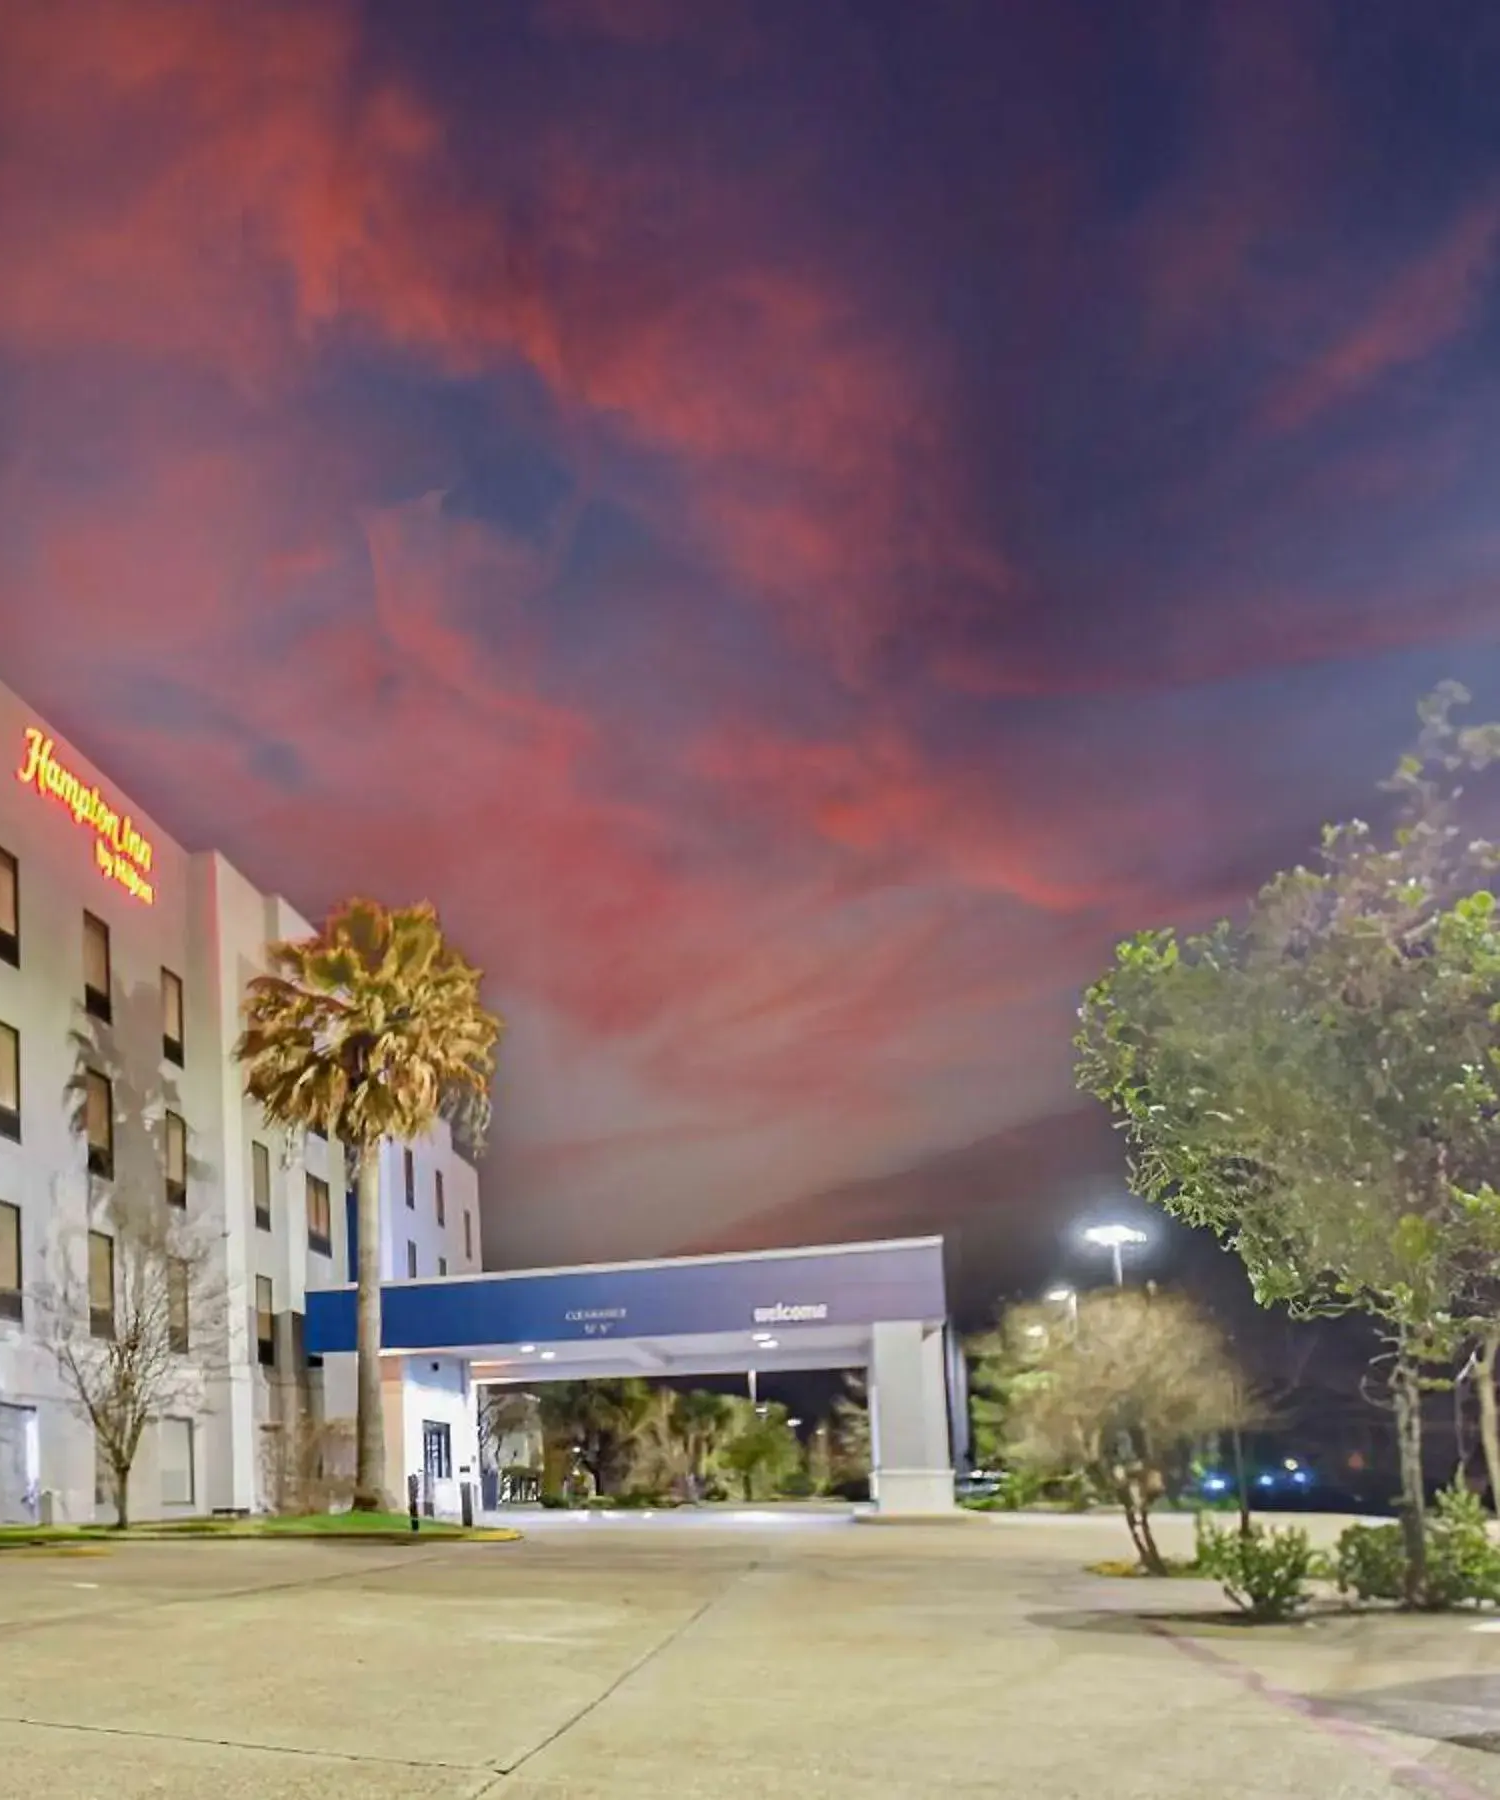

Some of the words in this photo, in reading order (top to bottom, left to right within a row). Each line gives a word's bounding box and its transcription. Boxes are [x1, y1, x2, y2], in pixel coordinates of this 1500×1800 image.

[17, 727, 119, 845] Hampton
[114, 816, 152, 873] Inn
[753, 1302, 828, 1322] welcome
